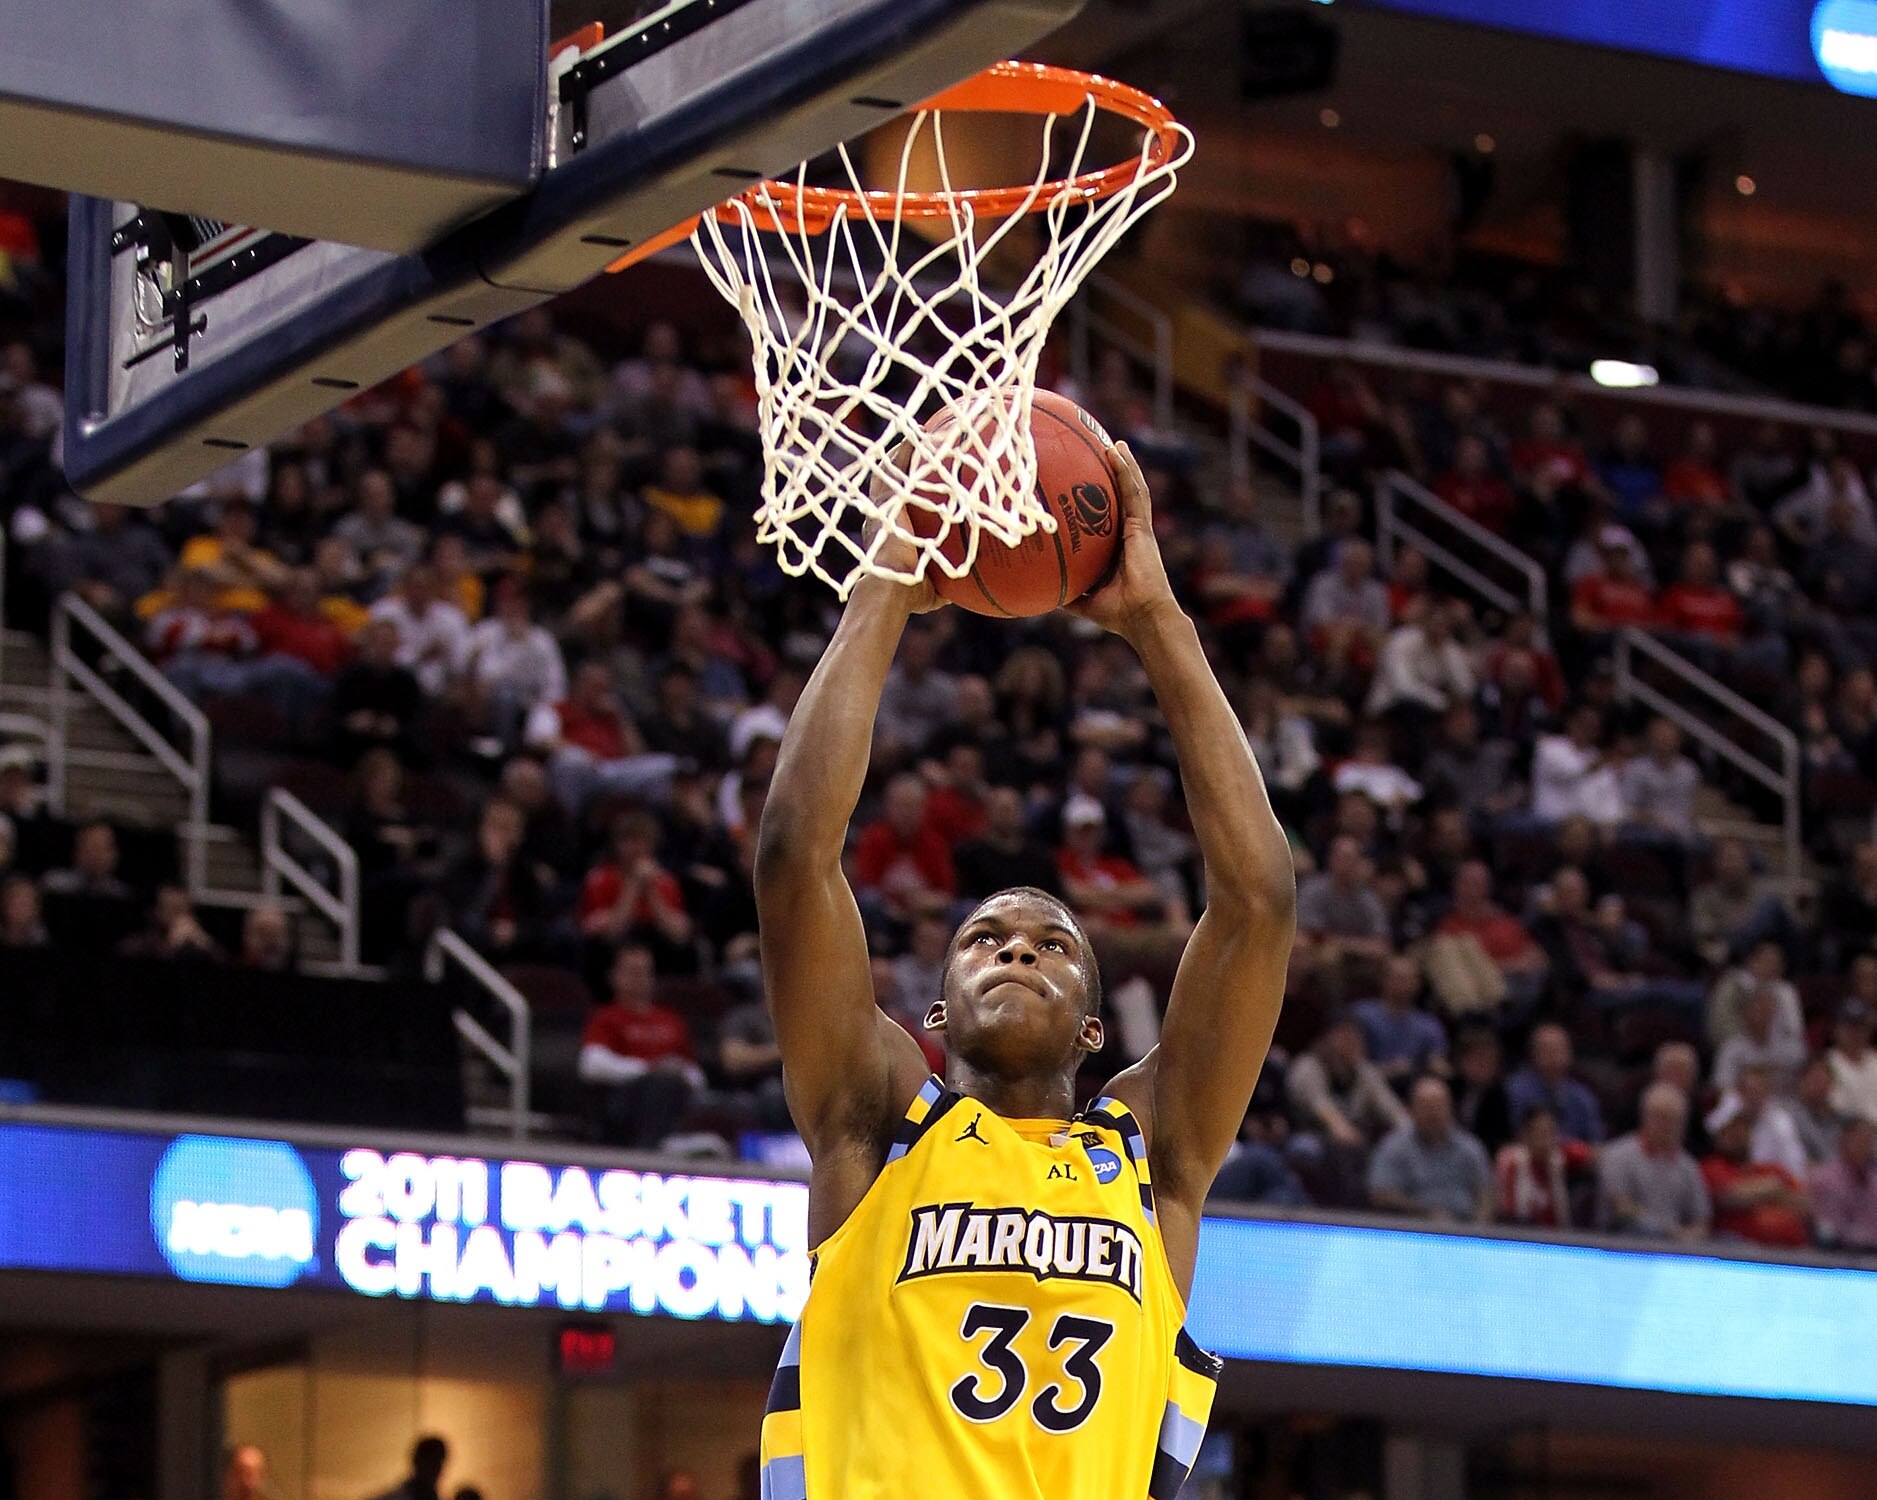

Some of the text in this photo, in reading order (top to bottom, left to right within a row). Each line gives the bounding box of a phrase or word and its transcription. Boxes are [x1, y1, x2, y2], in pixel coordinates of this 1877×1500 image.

[340, 1148, 488, 1228] 2011
[1046, 1163, 1078, 1182] AL
[949, 1300, 1115, 1435] 33
